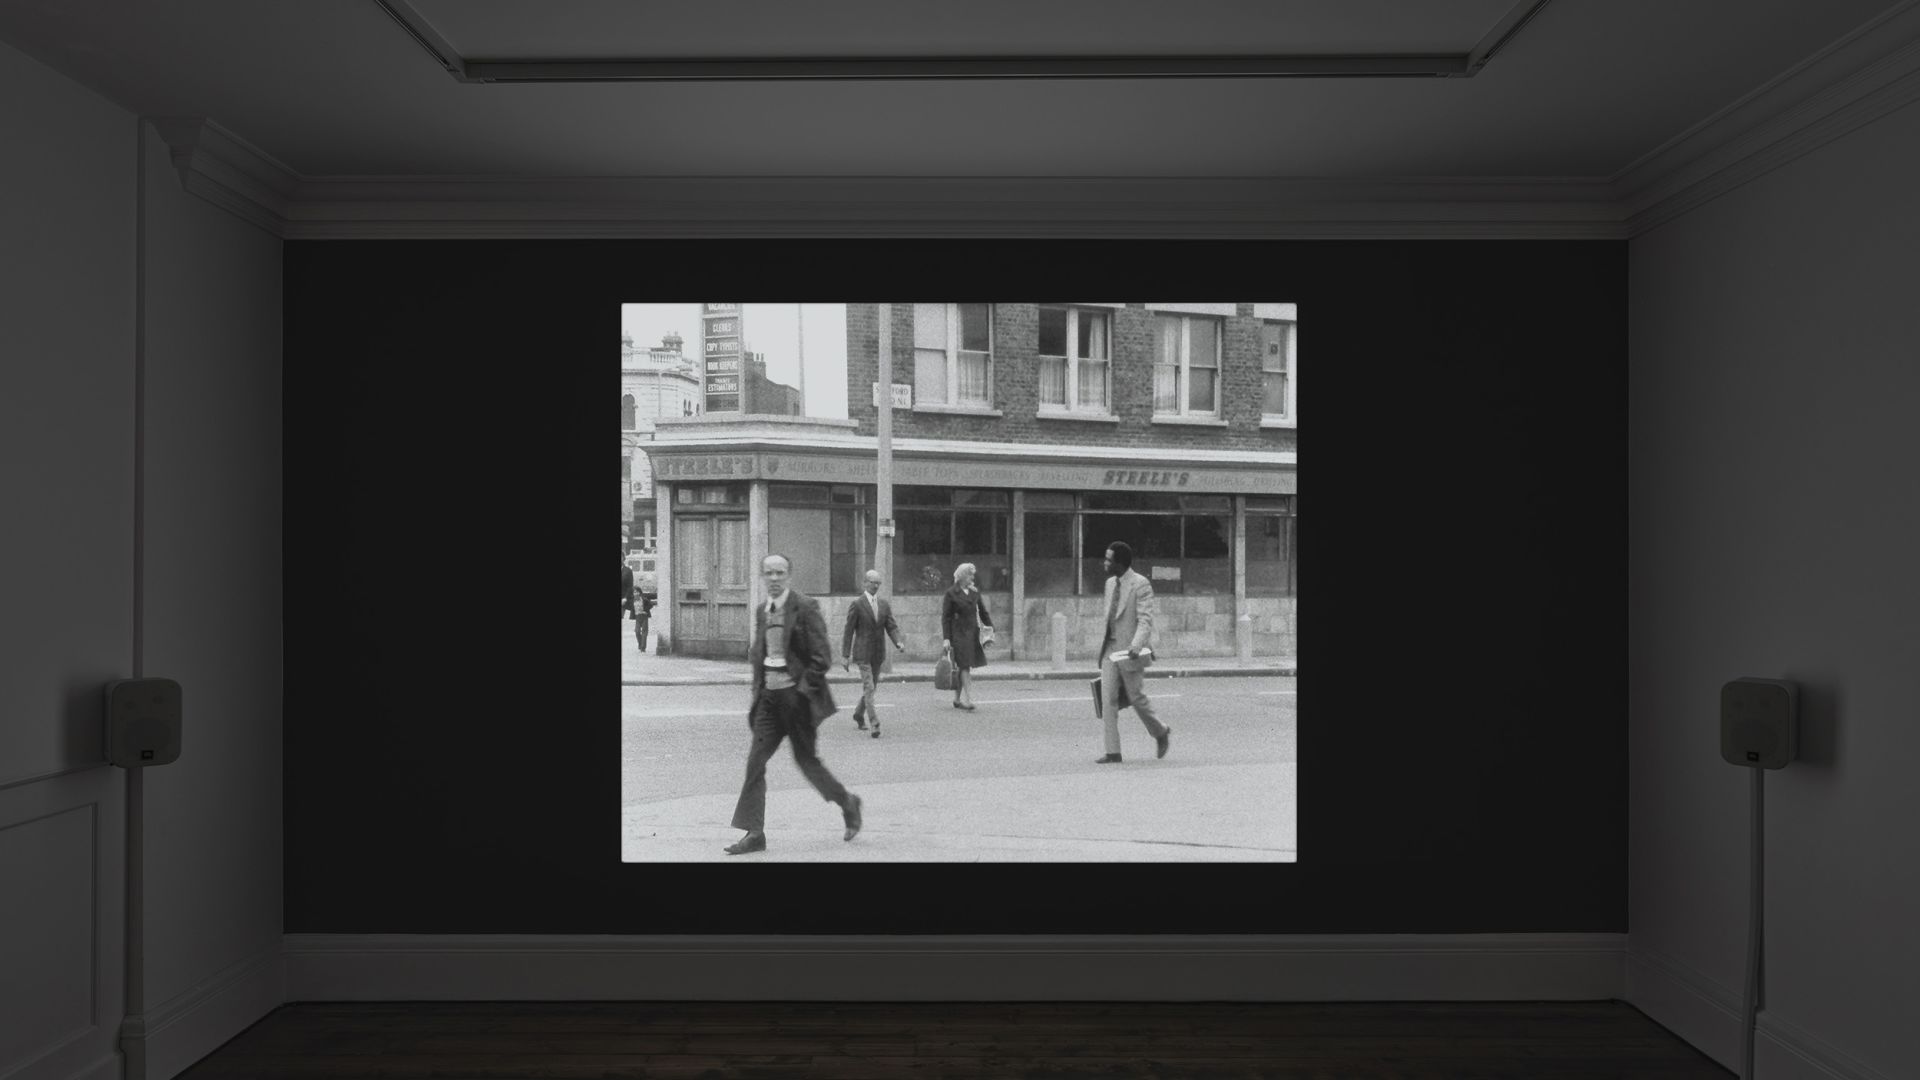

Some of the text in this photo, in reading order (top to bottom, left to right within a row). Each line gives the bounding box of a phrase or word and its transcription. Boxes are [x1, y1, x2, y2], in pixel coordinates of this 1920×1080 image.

[706, 343, 718, 352] COPY
[658, 457, 753, 475] STEELE'S
[1103, 470, 1189, 486] STEELE'S
